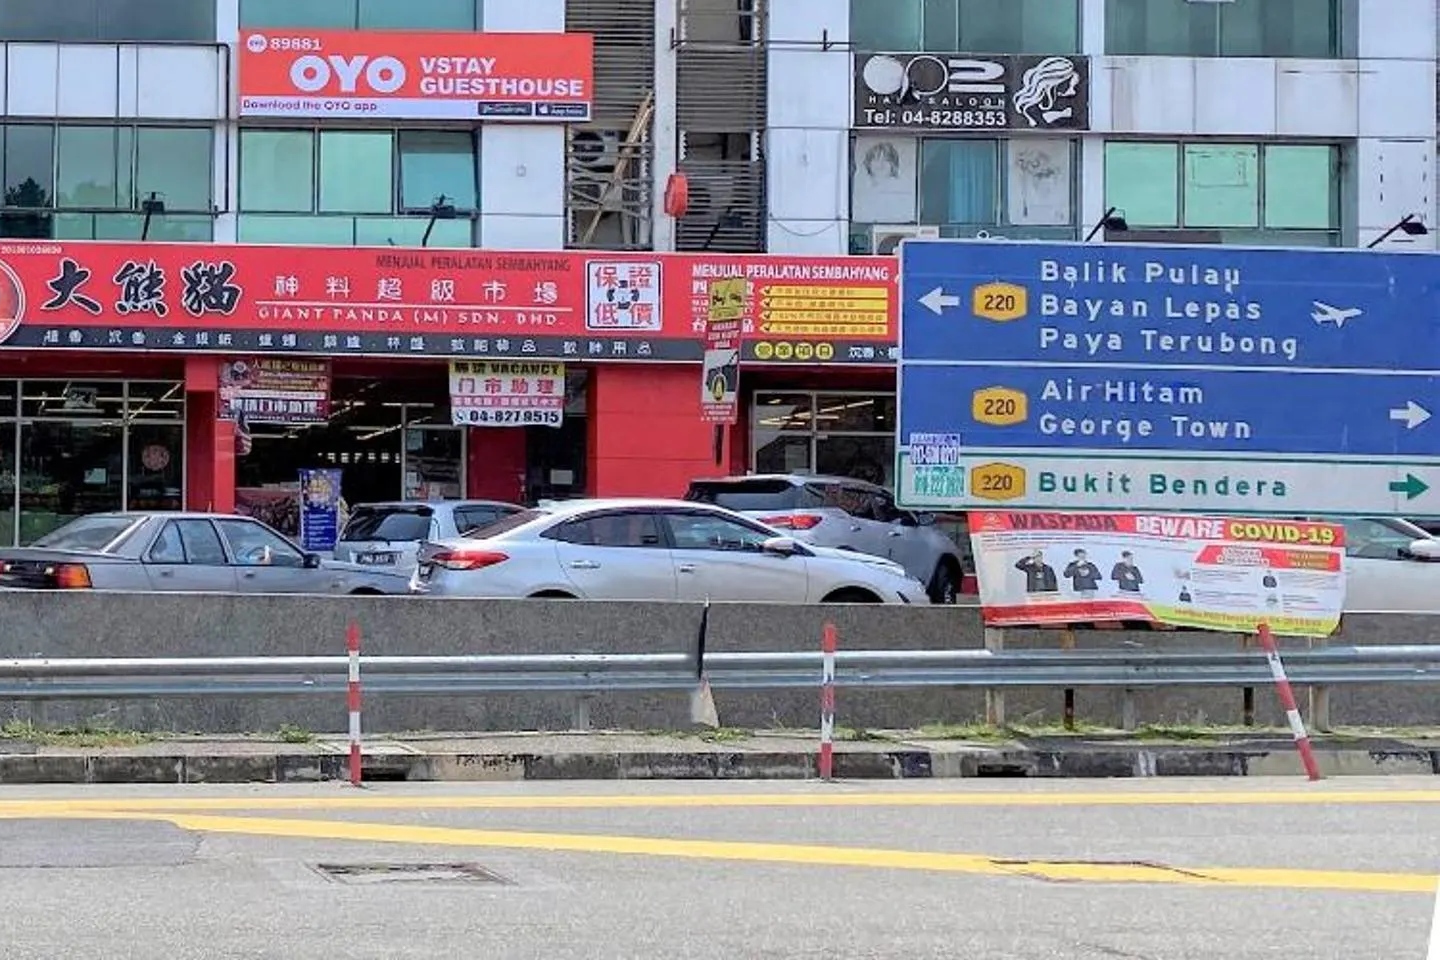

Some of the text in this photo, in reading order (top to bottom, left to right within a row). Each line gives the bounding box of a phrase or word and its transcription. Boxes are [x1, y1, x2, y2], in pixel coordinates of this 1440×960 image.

[270, 37, 323, 51] 89881
[290, 55, 407, 93] OYO
[419, 56, 496, 74] VSTAY
[419, 77, 584, 97] GUESTHOUSE
[243, 99, 377, 112] Download the OYO app
[863, 109, 1007, 126] Tel: 04-8288353
[376, 254, 572, 272] MENJUAL PERALATAN SEMBAHYANG
[692, 264, 889, 281] MENJUAL PERALATAN SEMBAHYANG
[1040, 261, 1240, 287] Balik Pulau
[40, 257, 243, 317] 大熊貓
[984, 294, 1015, 311] 220
[1040, 294, 1262, 323] Bayan Lepas
[258, 306, 325, 320] GIANT
[332, 307, 404, 322] PANDA
[414, 310, 448, 326] (M)
[458, 311, 506, 325] SDN.
[1040, 327, 1298, 360] Paya Terubong
[491, 362, 559, 376] VACANCY
[458, 377, 555, 395] 门市助理
[1041, 379, 1093, 402] Air
[984, 398, 1015, 416] 220
[1039, 413, 1251, 442] George Town
[982, 474, 1013, 491] 220
[1039, 471, 1287, 497] Bukit Bendera
[1009, 512, 1336, 545] WASPADA BEWARE COVID-19
